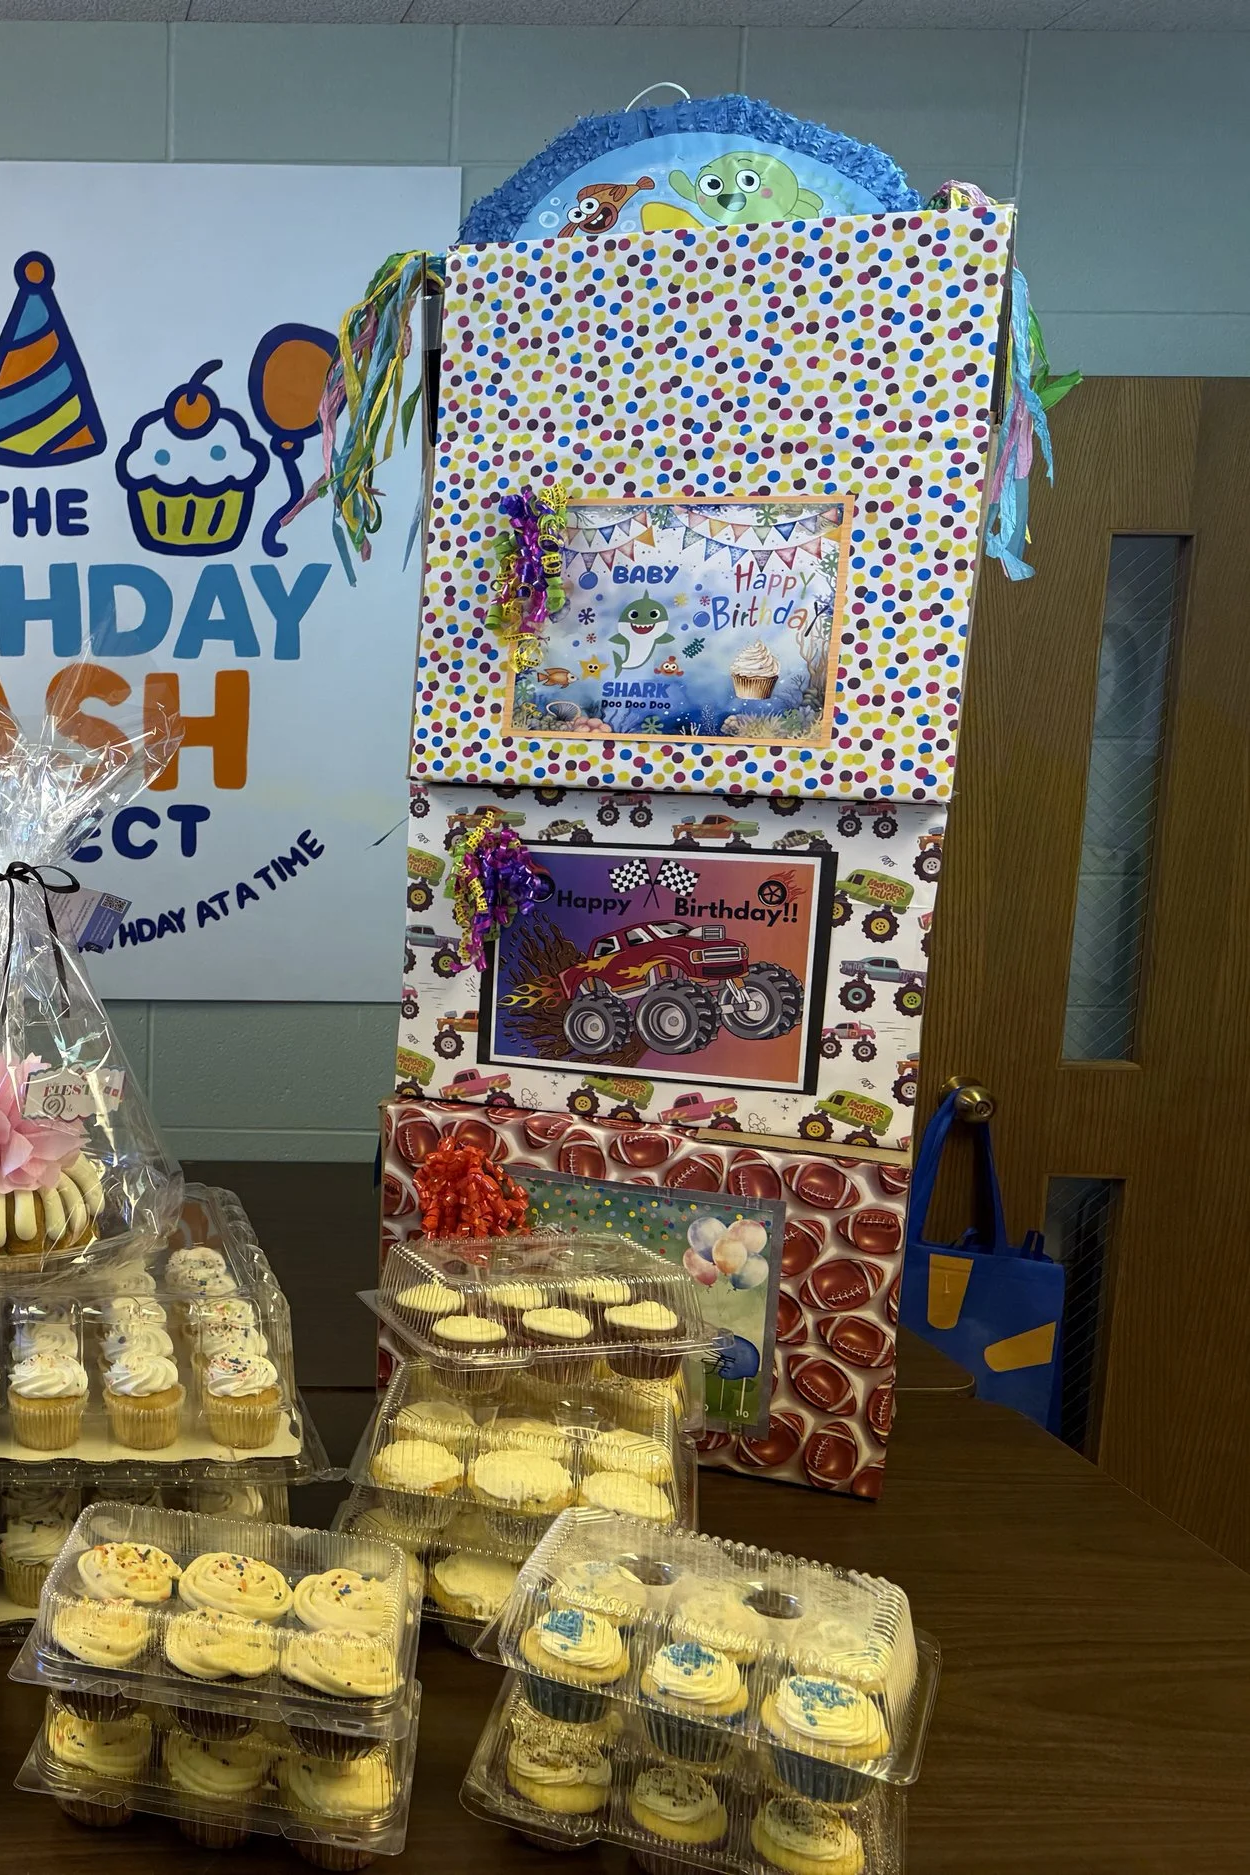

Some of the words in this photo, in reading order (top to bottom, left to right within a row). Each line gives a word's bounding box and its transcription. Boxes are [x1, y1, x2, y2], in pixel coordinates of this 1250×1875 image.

[612, 565, 679, 585] BABY
[734, 561, 816, 600] Happy
[711, 595, 830, 638] Birthday
[601, 681, 671, 699] SHARK
[601, 699, 624, 709] Doo
[625, 700, 647, 709] Doo
[649, 700, 671, 710] Doo
[196, 890, 230, 928] AT
[236, 882, 260, 910] A
[253, 829, 326, 890] TIME
[866, 878, 906, 898] MONSTER
[868, 886, 897, 903] TRUCK
[557, 890, 632, 916] Happy
[674, 896, 799, 928] Birthday!!
[847, 1098, 885, 1119] MONSTER
[849, 1106, 876, 1124] TRUCK
